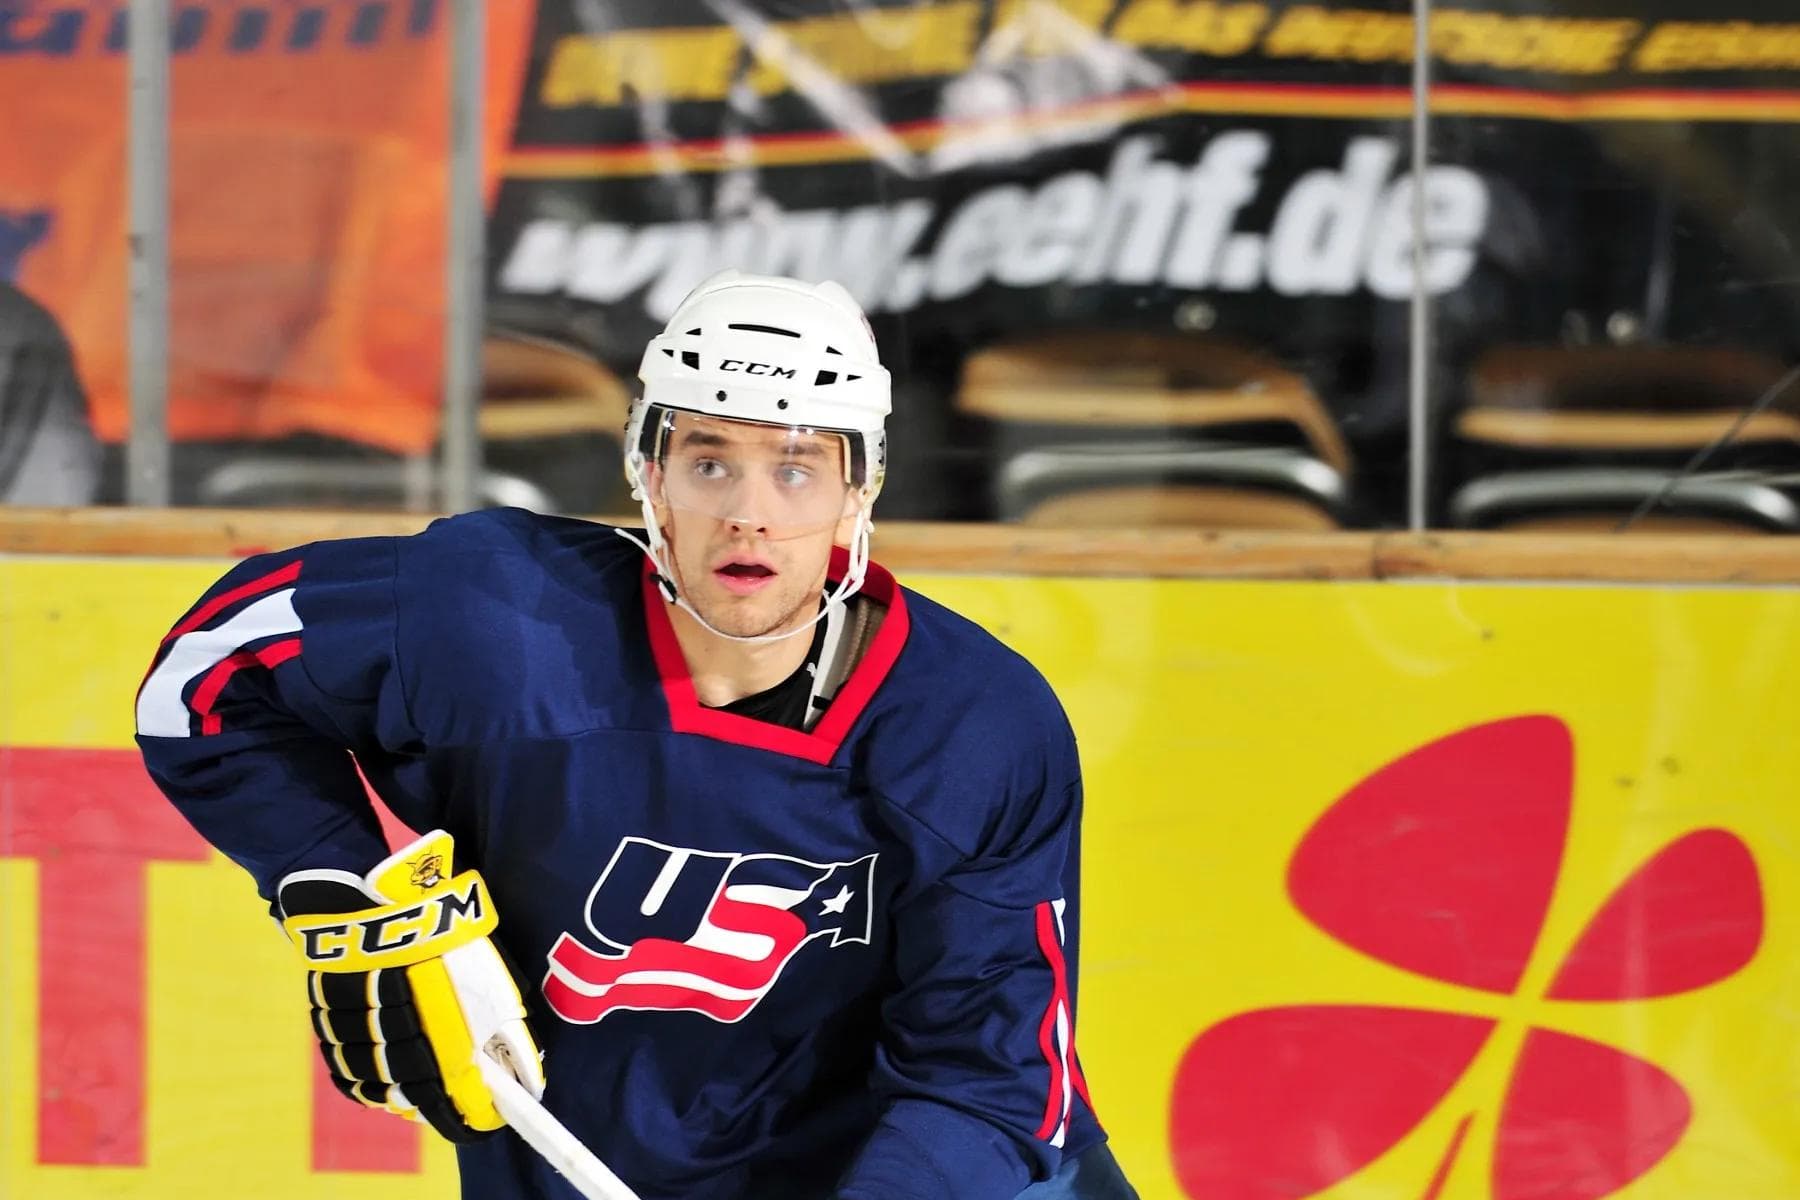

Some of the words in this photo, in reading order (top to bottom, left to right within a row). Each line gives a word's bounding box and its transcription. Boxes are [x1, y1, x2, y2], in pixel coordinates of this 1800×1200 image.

[719, 358, 796, 380] CCM
[300, 882, 483, 961] CCM
[542, 836, 880, 1025] USA
